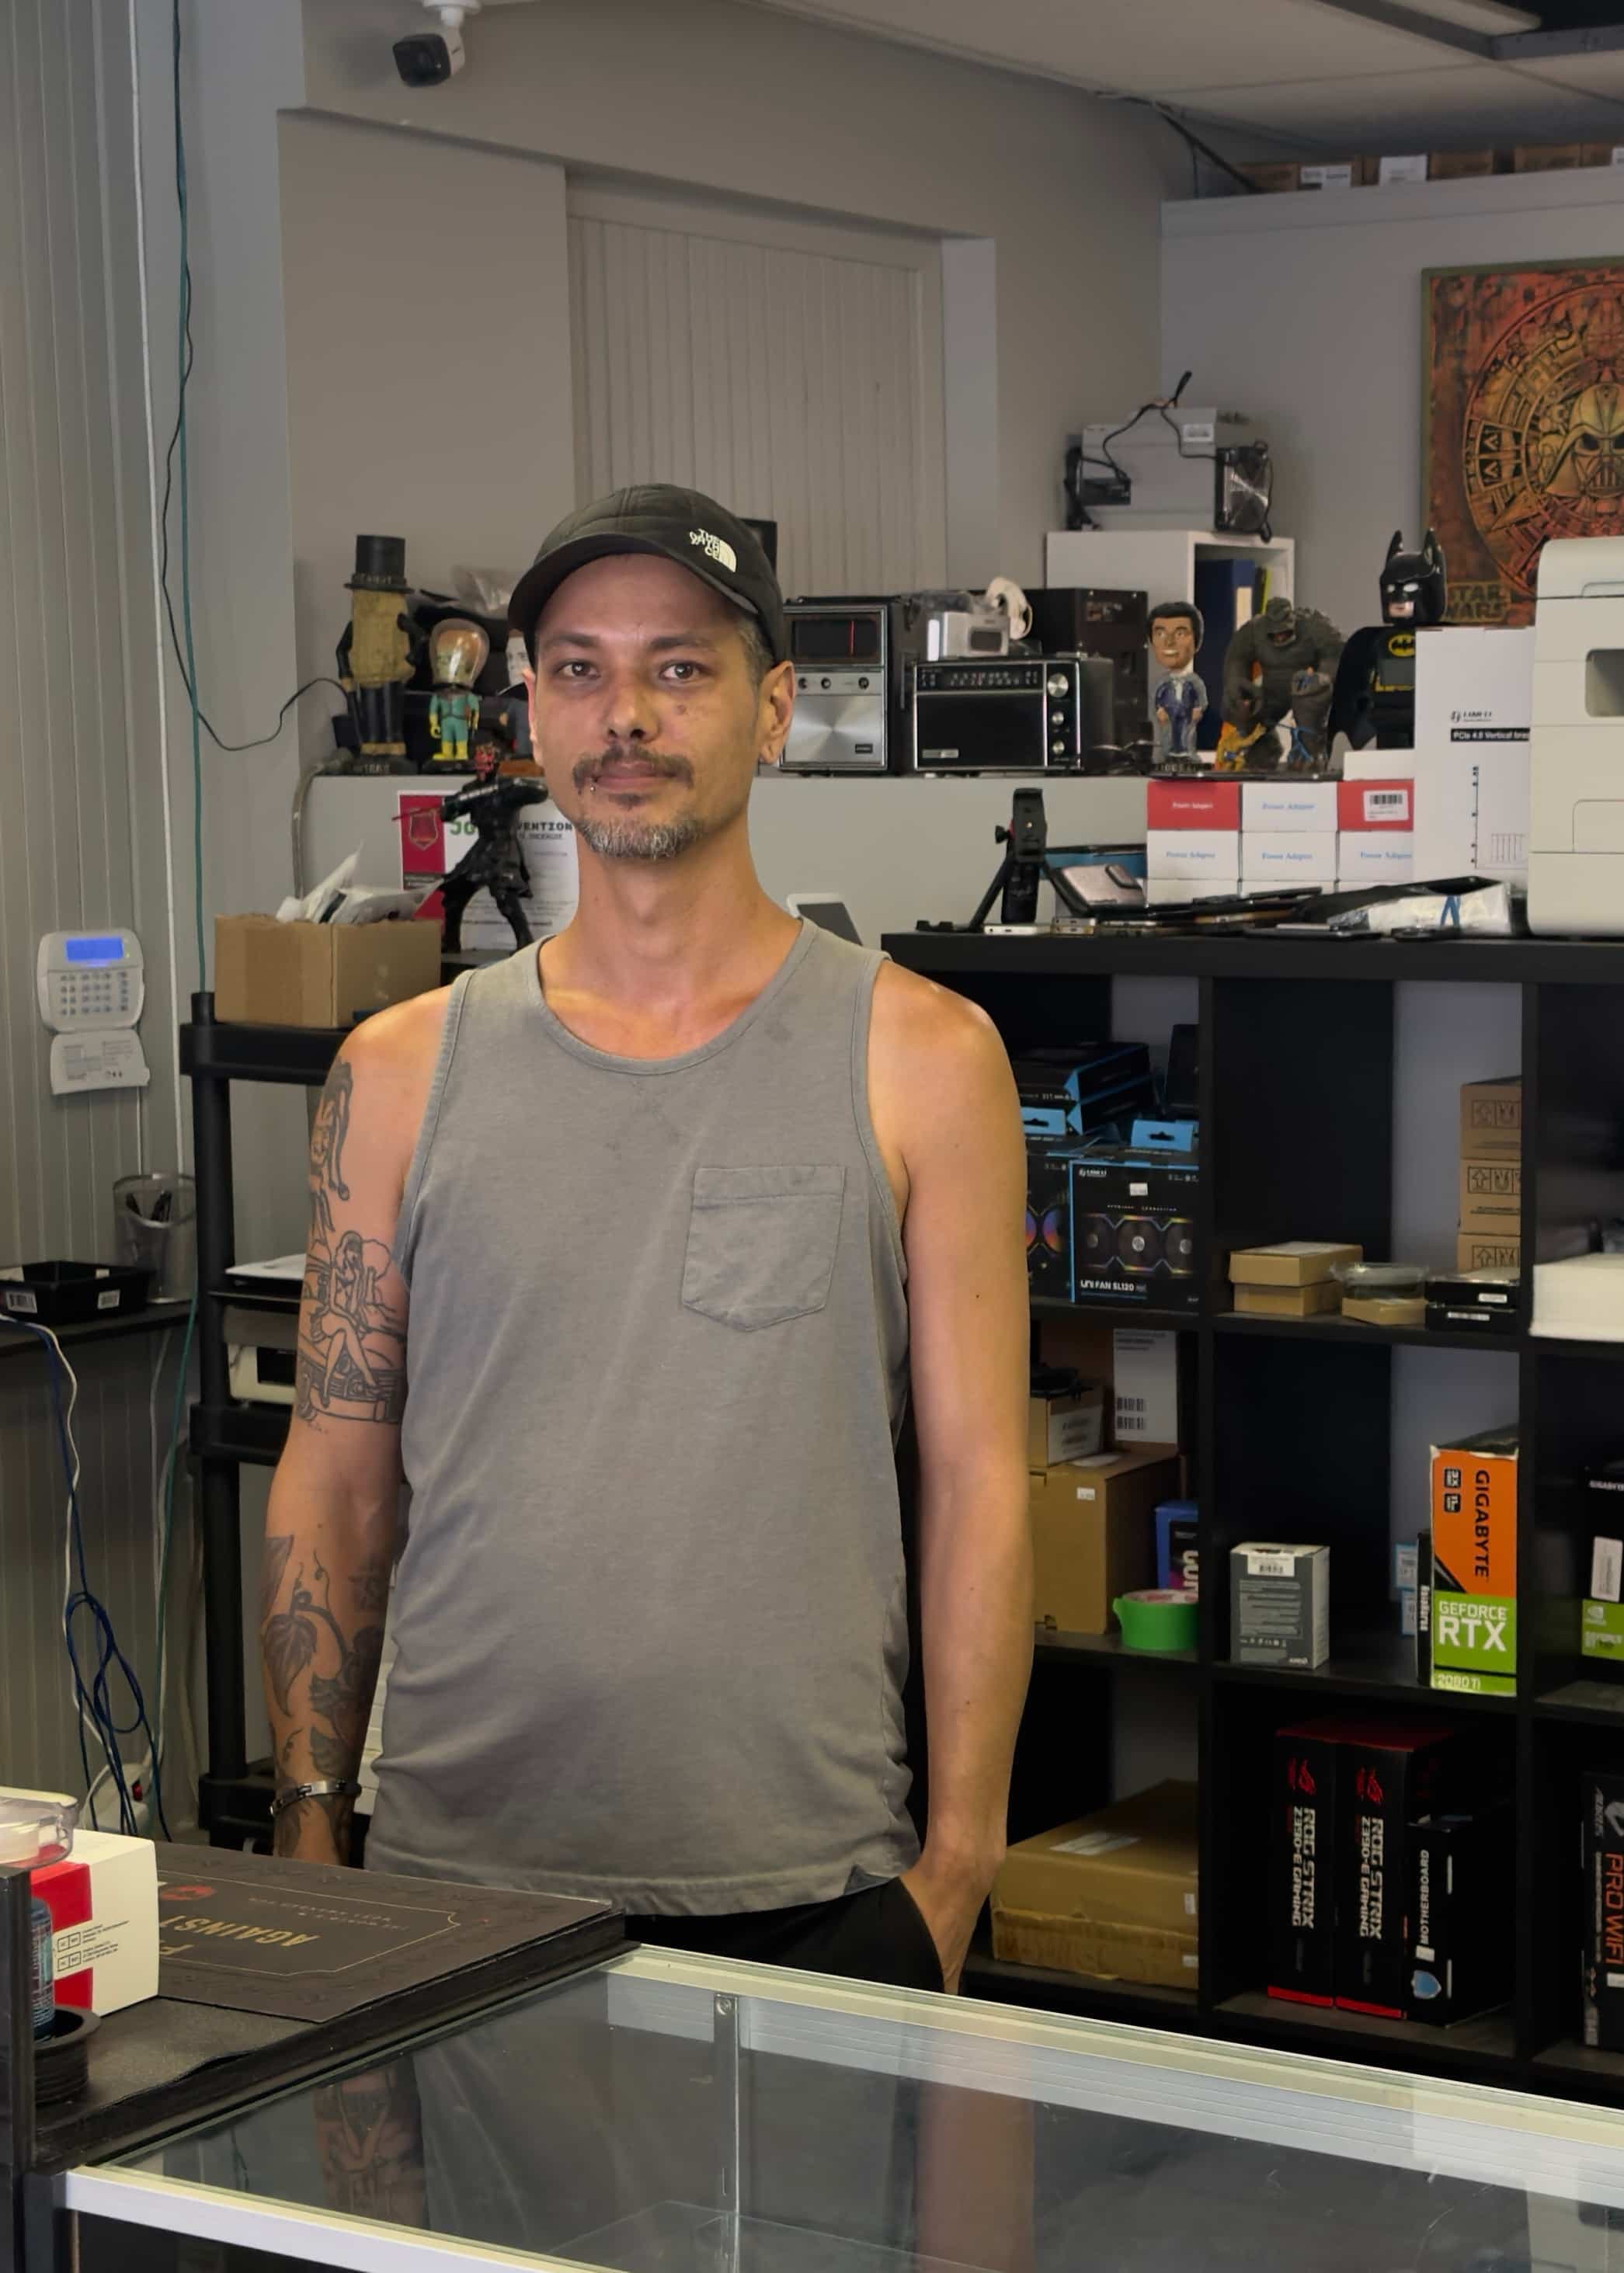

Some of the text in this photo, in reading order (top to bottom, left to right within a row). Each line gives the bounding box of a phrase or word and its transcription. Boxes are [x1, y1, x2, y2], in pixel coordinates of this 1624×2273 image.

[1095, 1281, 1111, 1290] FAN
[1113, 1282, 1135, 1291] SL120
[1475, 1470, 1490, 1577] GIGABYTE
[1438, 1615, 1507, 1653] RTX
[1439, 1600, 1508, 1621] GEFORCE
[1437, 1673, 1470, 1688] 2080
[1292, 1806, 1303, 1927] Z390-E GAMING
[1302, 1807, 1316, 1929] ROG STRIX
[1359, 1816, 1371, 1938] Z390-E GAMING
[1369, 1817, 1384, 1939] ROG STRIX
[1420, 1849, 1430, 1945] MOTHERBOARD
[1605, 1853, 1624, 1965] PRO WIFI
